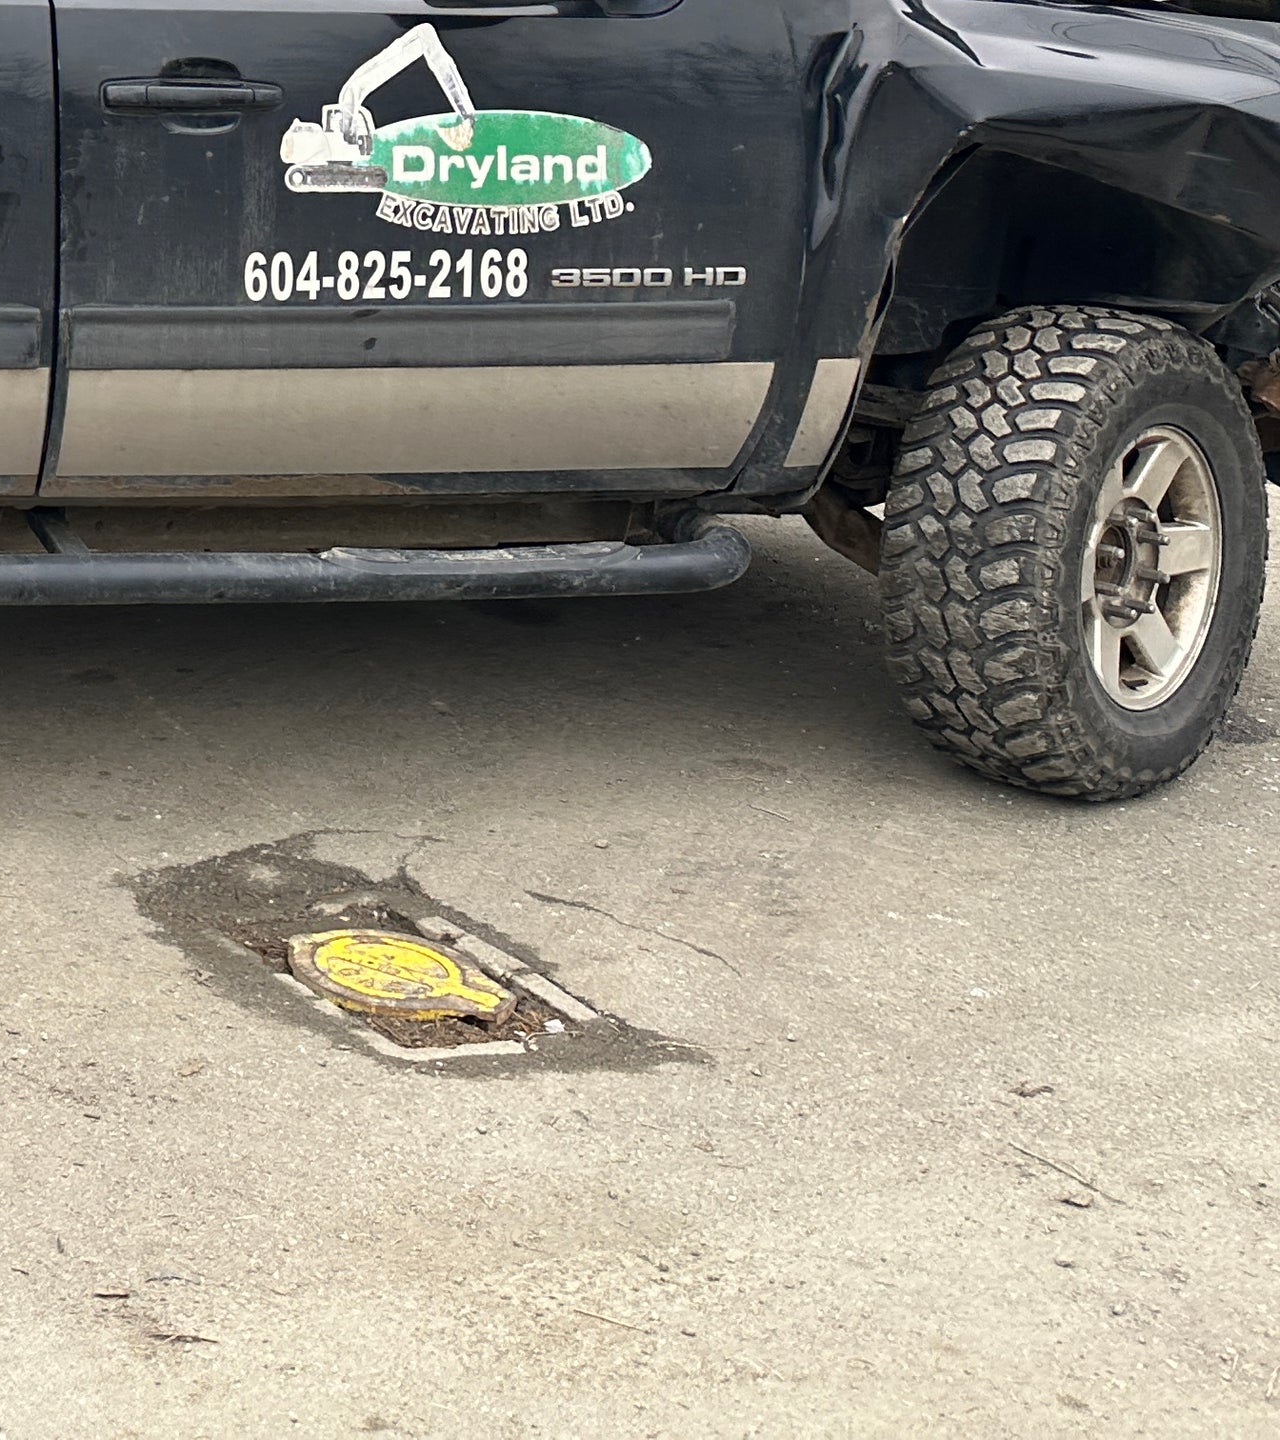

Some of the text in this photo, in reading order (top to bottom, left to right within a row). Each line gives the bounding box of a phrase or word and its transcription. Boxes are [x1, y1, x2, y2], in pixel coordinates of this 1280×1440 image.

[393, 145, 606, 189] Dryland
[376, 190, 635, 235] EXCAVATING LTD.
[244, 248, 528, 300] 604-825-2168
[551, 266, 747, 287] 3500 HD
